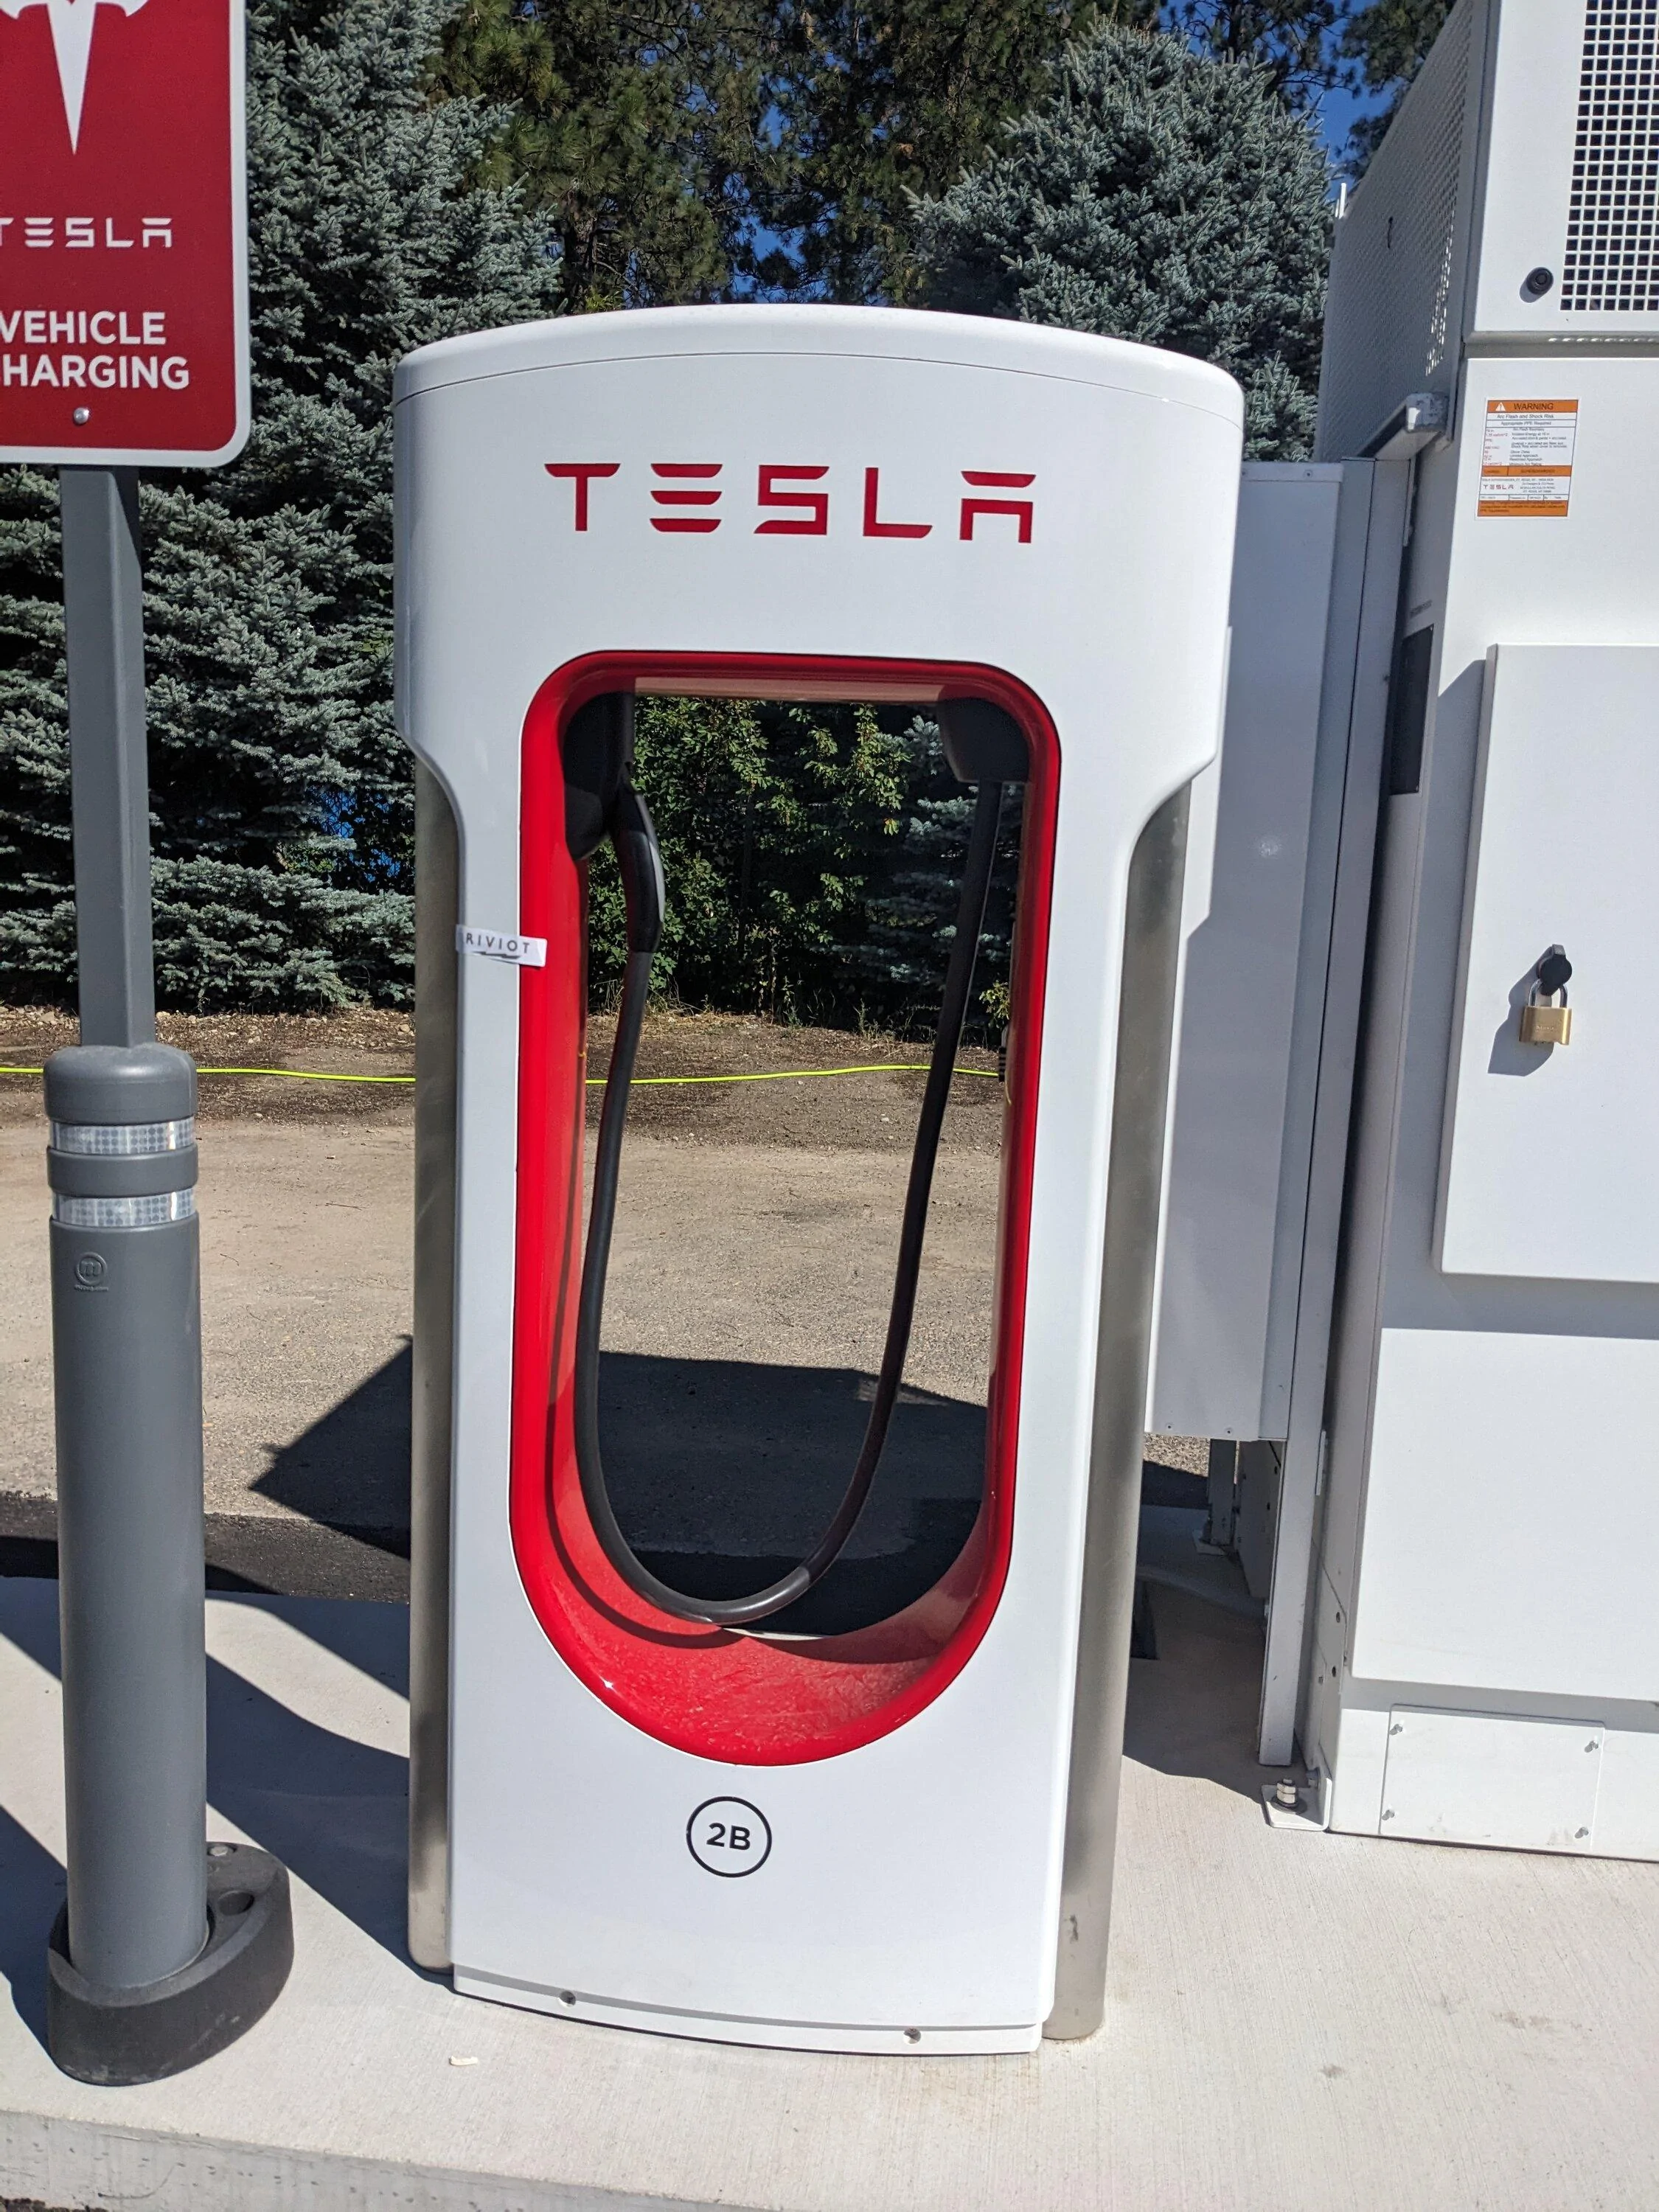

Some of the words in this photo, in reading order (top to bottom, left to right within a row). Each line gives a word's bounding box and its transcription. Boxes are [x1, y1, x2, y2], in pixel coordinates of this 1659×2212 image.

[0, 310, 166, 345] VEHICLE
[2, 354, 189, 389] HARGING
[544, 462, 1036, 543] TESLA
[466, 933, 530, 953] RIVIOT
[706, 1822, 751, 1851] 2B
